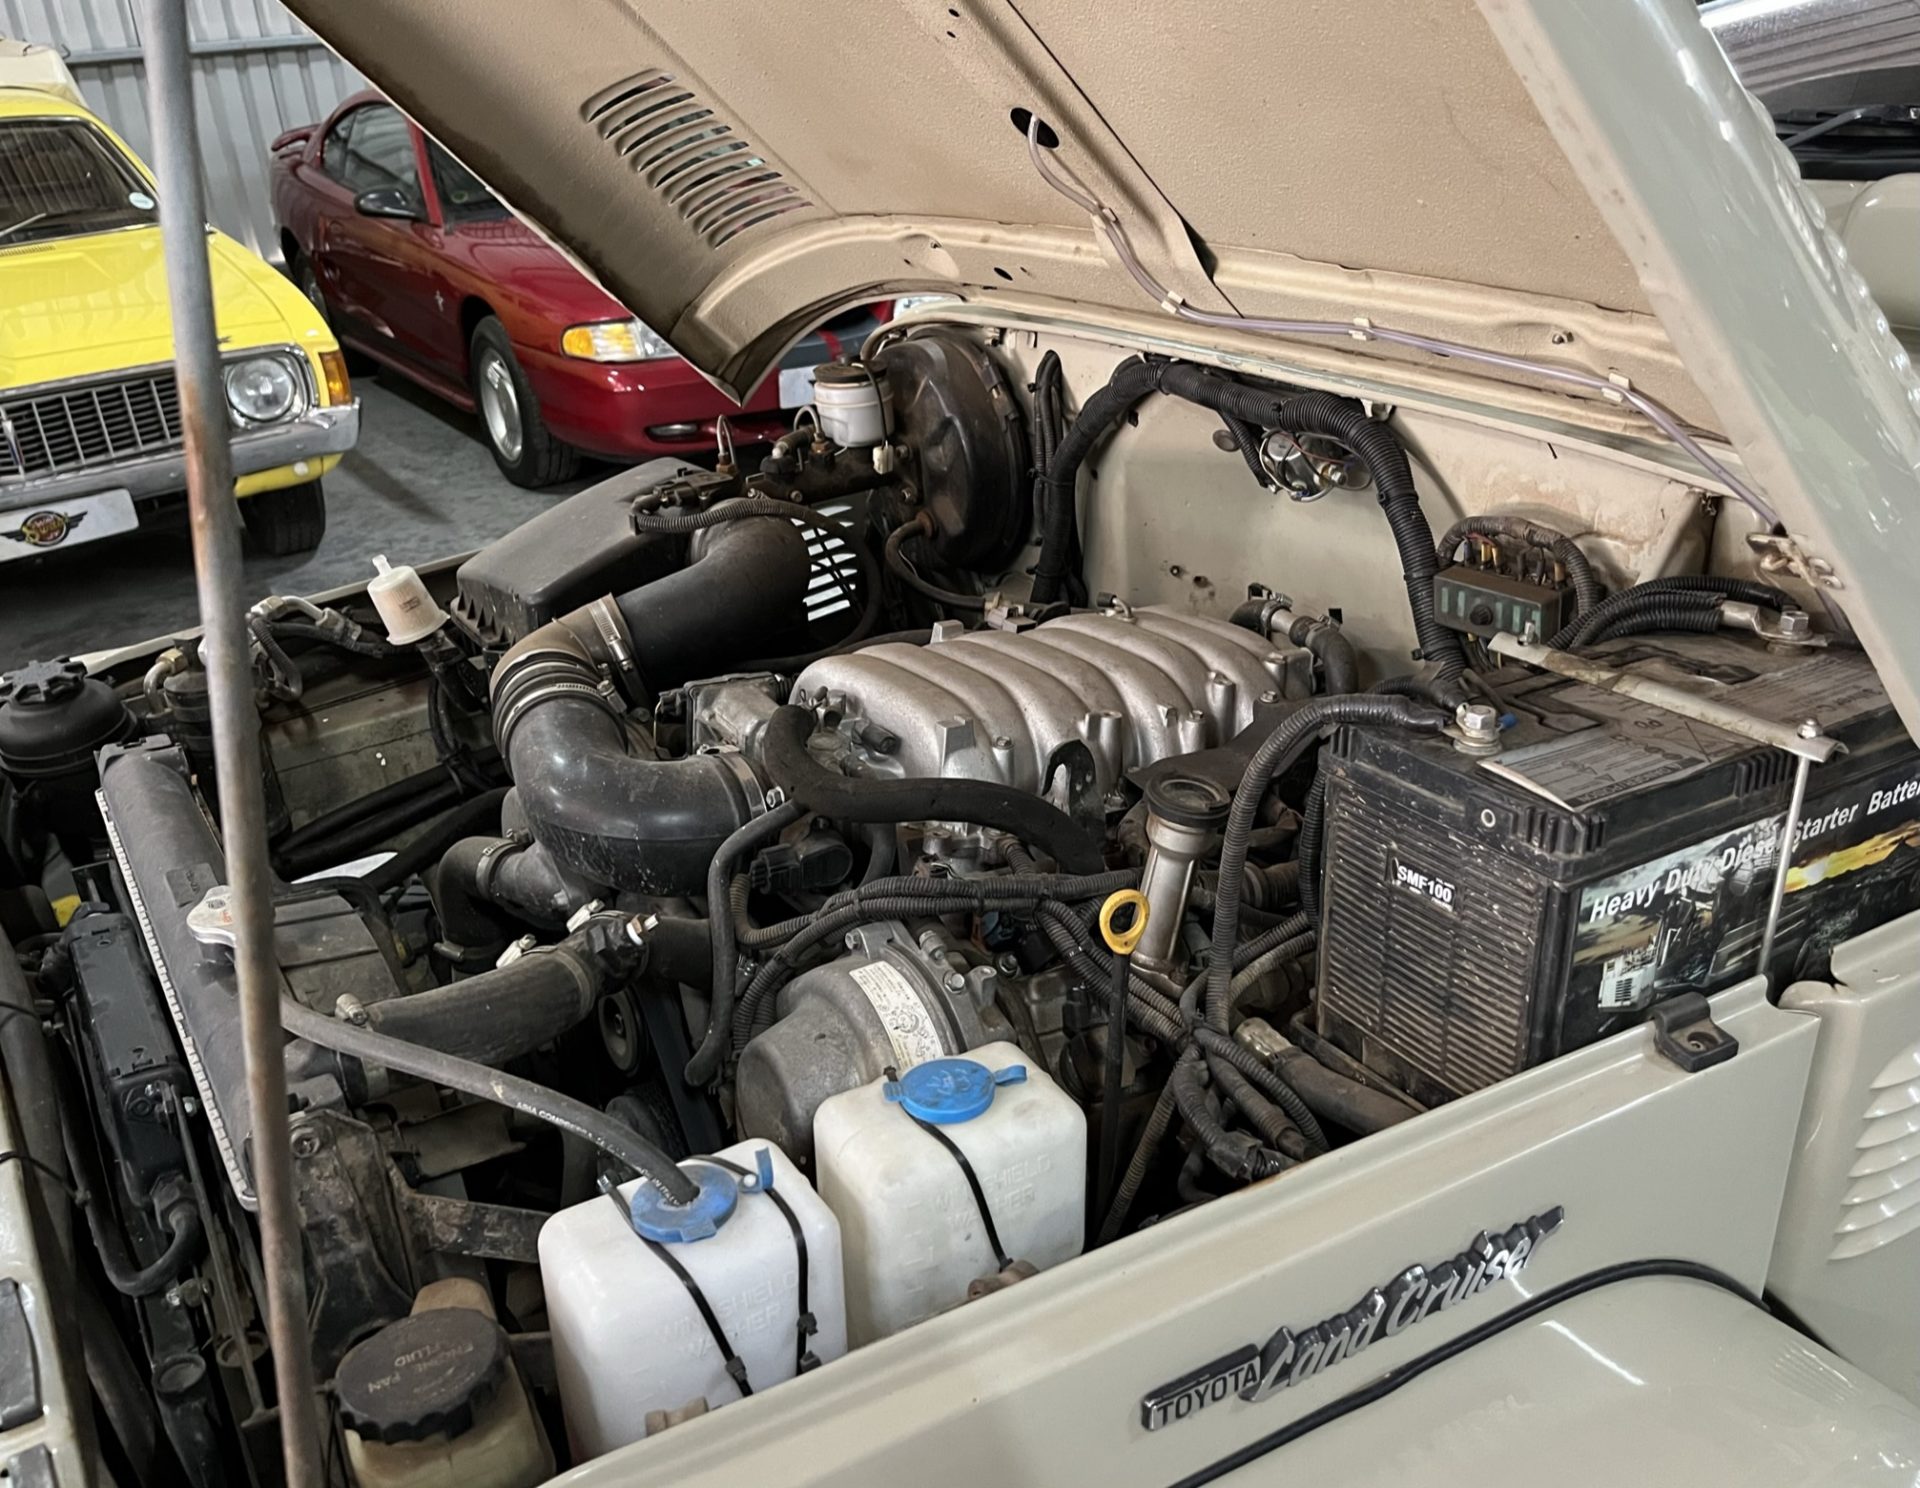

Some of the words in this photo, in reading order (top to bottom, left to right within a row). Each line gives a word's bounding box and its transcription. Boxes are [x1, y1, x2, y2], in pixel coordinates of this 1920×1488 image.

[1397, 865, 1452, 903] SMF100
[1589, 881, 1660, 923] Heavy
[1664, 857, 1717, 895] Duty
[1792, 804, 1859, 844] Starter
[934, 1152, 1053, 1213] WINSHIELD
[947, 1183, 1036, 1231] WAHER
[659, 1271, 799, 1340] WINSHIELD
[678, 1302, 782, 1358] WAHER
[1246, 1288, 1386, 1402] Land
[1384, 1206, 1564, 1339] Cruiser
[1157, 1361, 1258, 1425] TOYOTA
